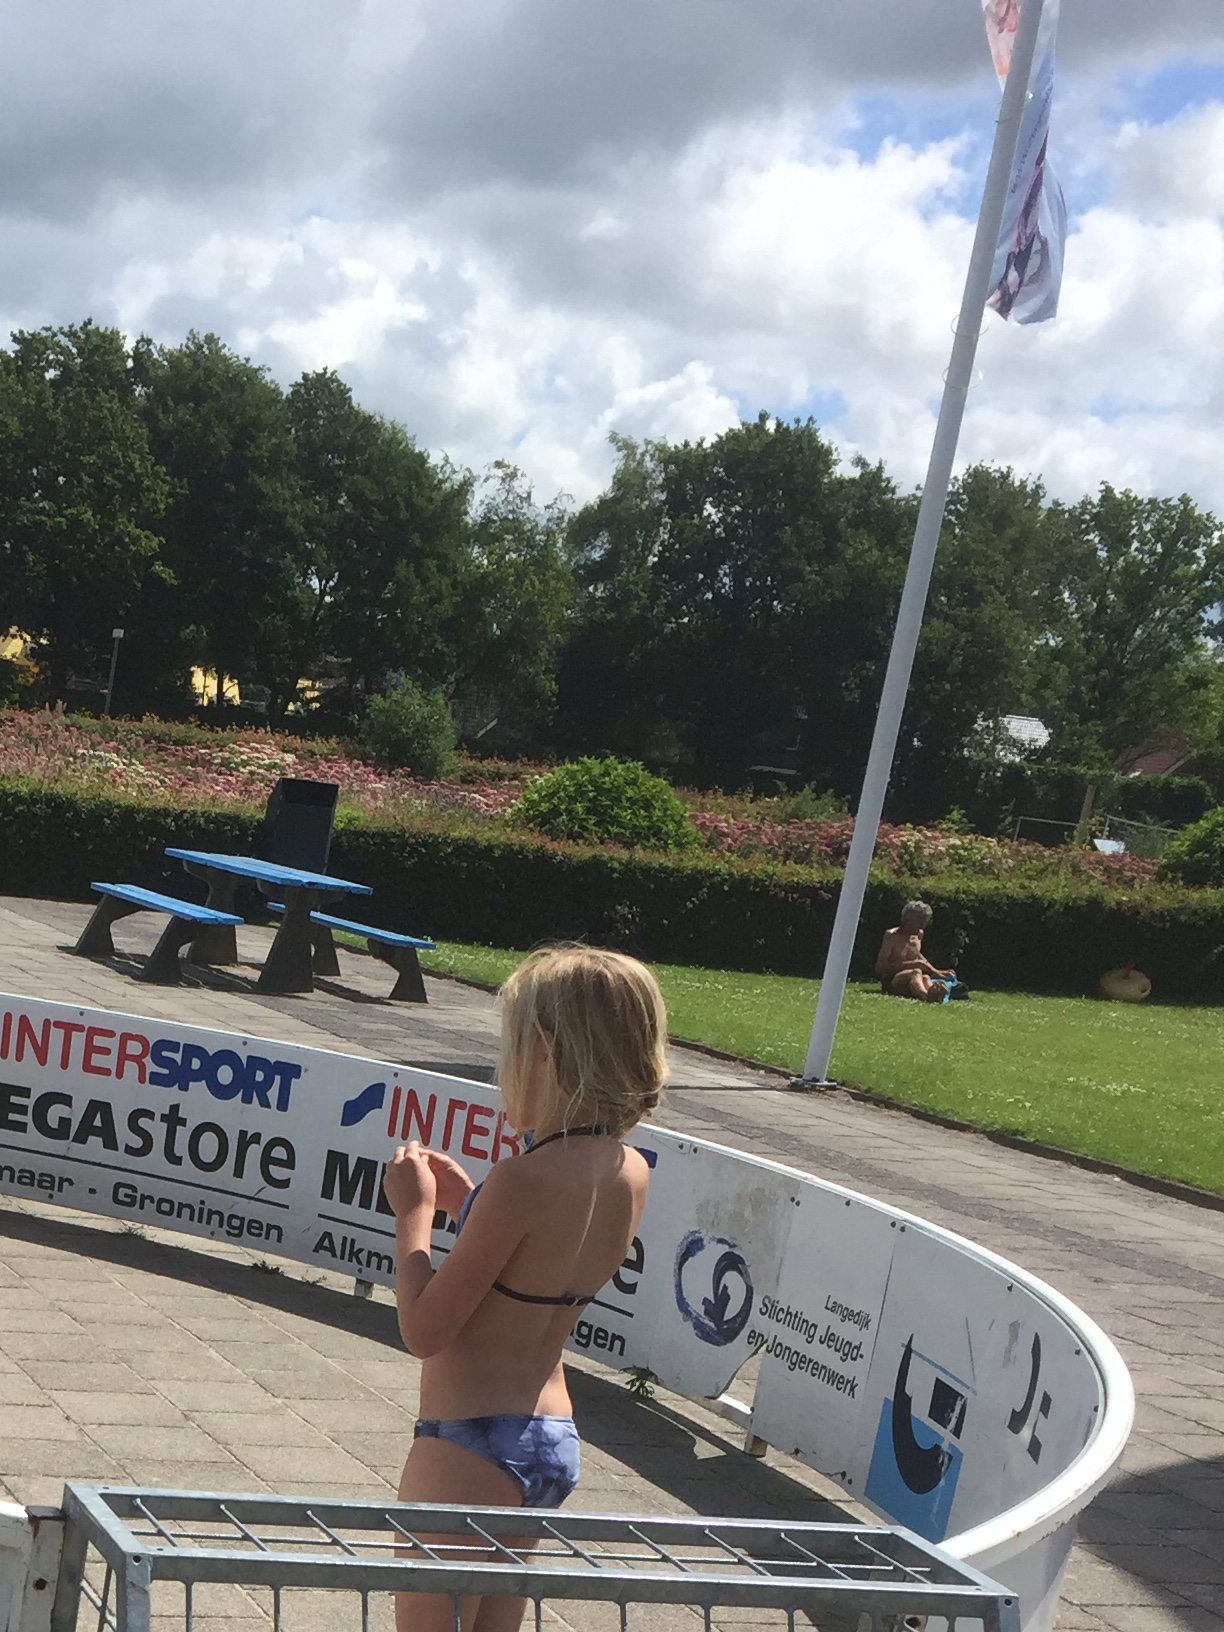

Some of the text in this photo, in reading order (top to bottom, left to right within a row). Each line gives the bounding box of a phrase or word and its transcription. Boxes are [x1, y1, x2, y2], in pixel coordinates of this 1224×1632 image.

[0, 1012, 302, 1113] INTERSPORT
[387, 1085, 532, 1164] INTER
[111, 1181, 284, 1243] Groningen
[312, 1230, 397, 1275] Alkm
[759, 1294, 865, 1363] Stichting Jeugd-
[824, 1294, 872, 1332] Langedijk
[766, 1334, 858, 1399] Jongerenwerk
